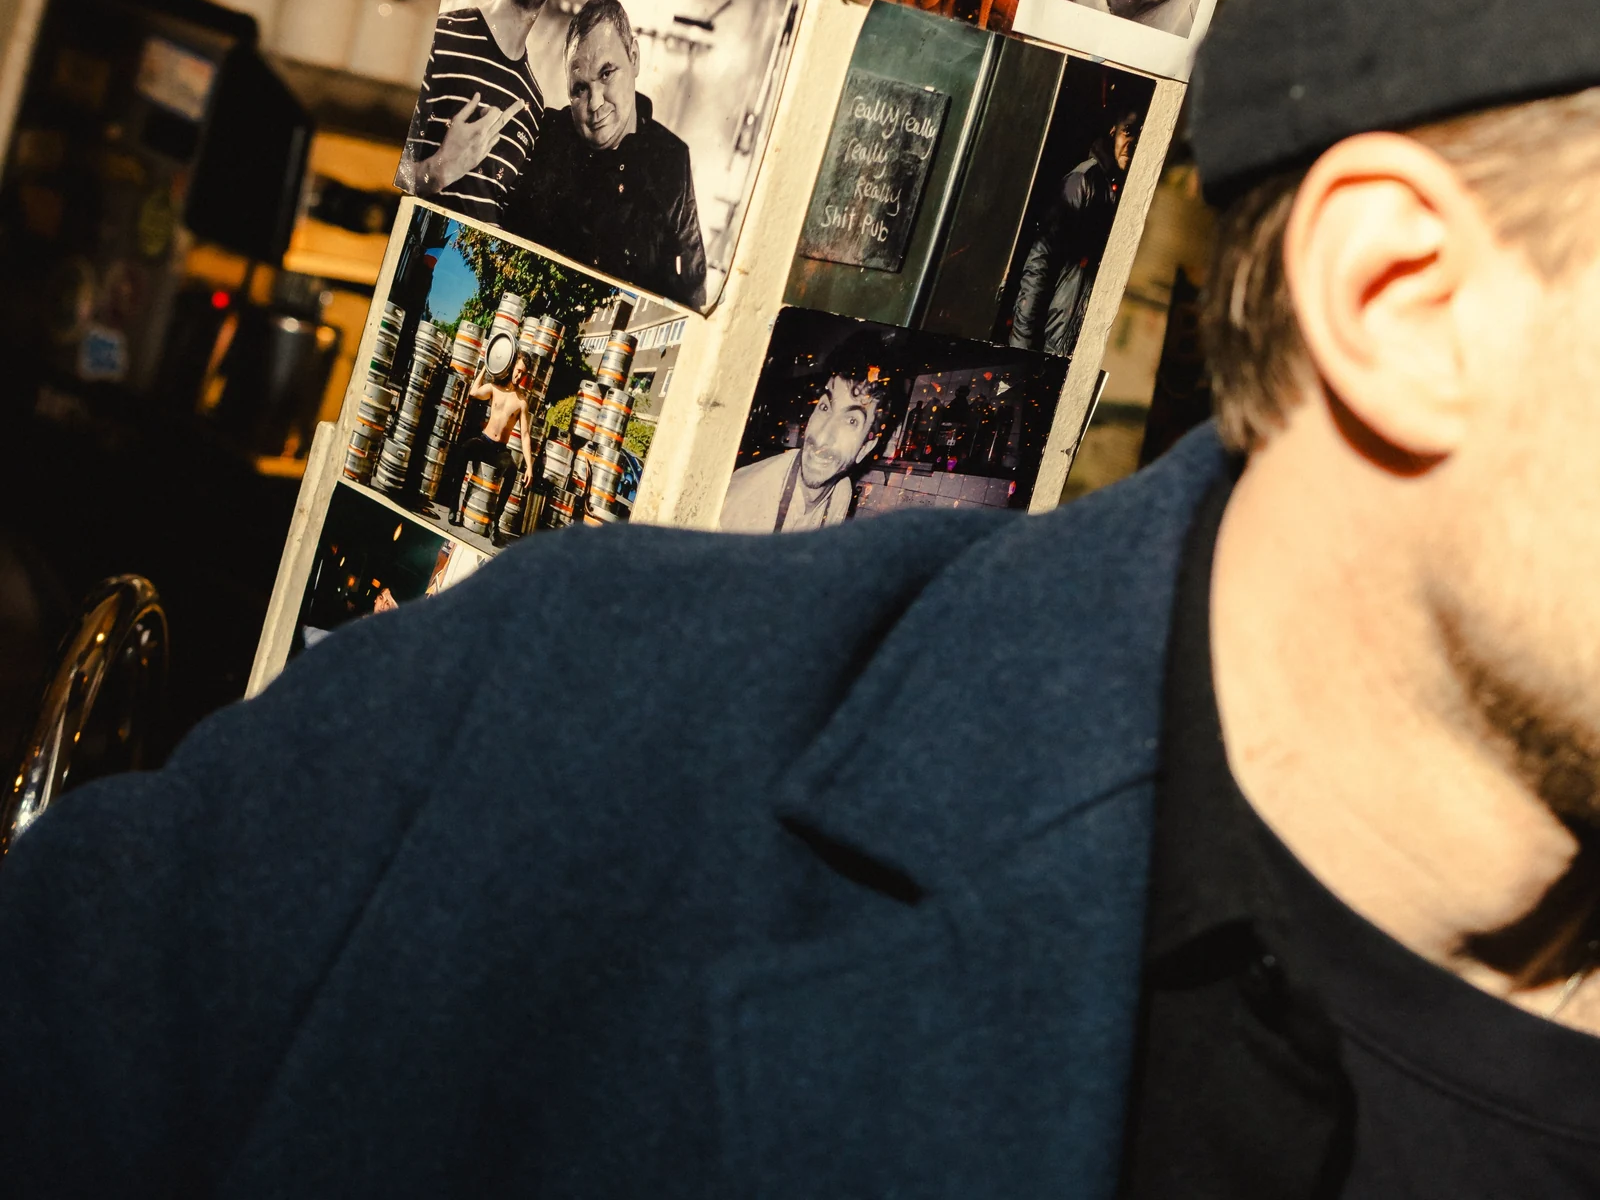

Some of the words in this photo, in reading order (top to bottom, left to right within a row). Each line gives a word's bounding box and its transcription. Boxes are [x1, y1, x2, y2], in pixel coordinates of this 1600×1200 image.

[849, 95, 900, 140] really
[901, 112, 937, 160] really
[820, 204, 856, 232] Shit
